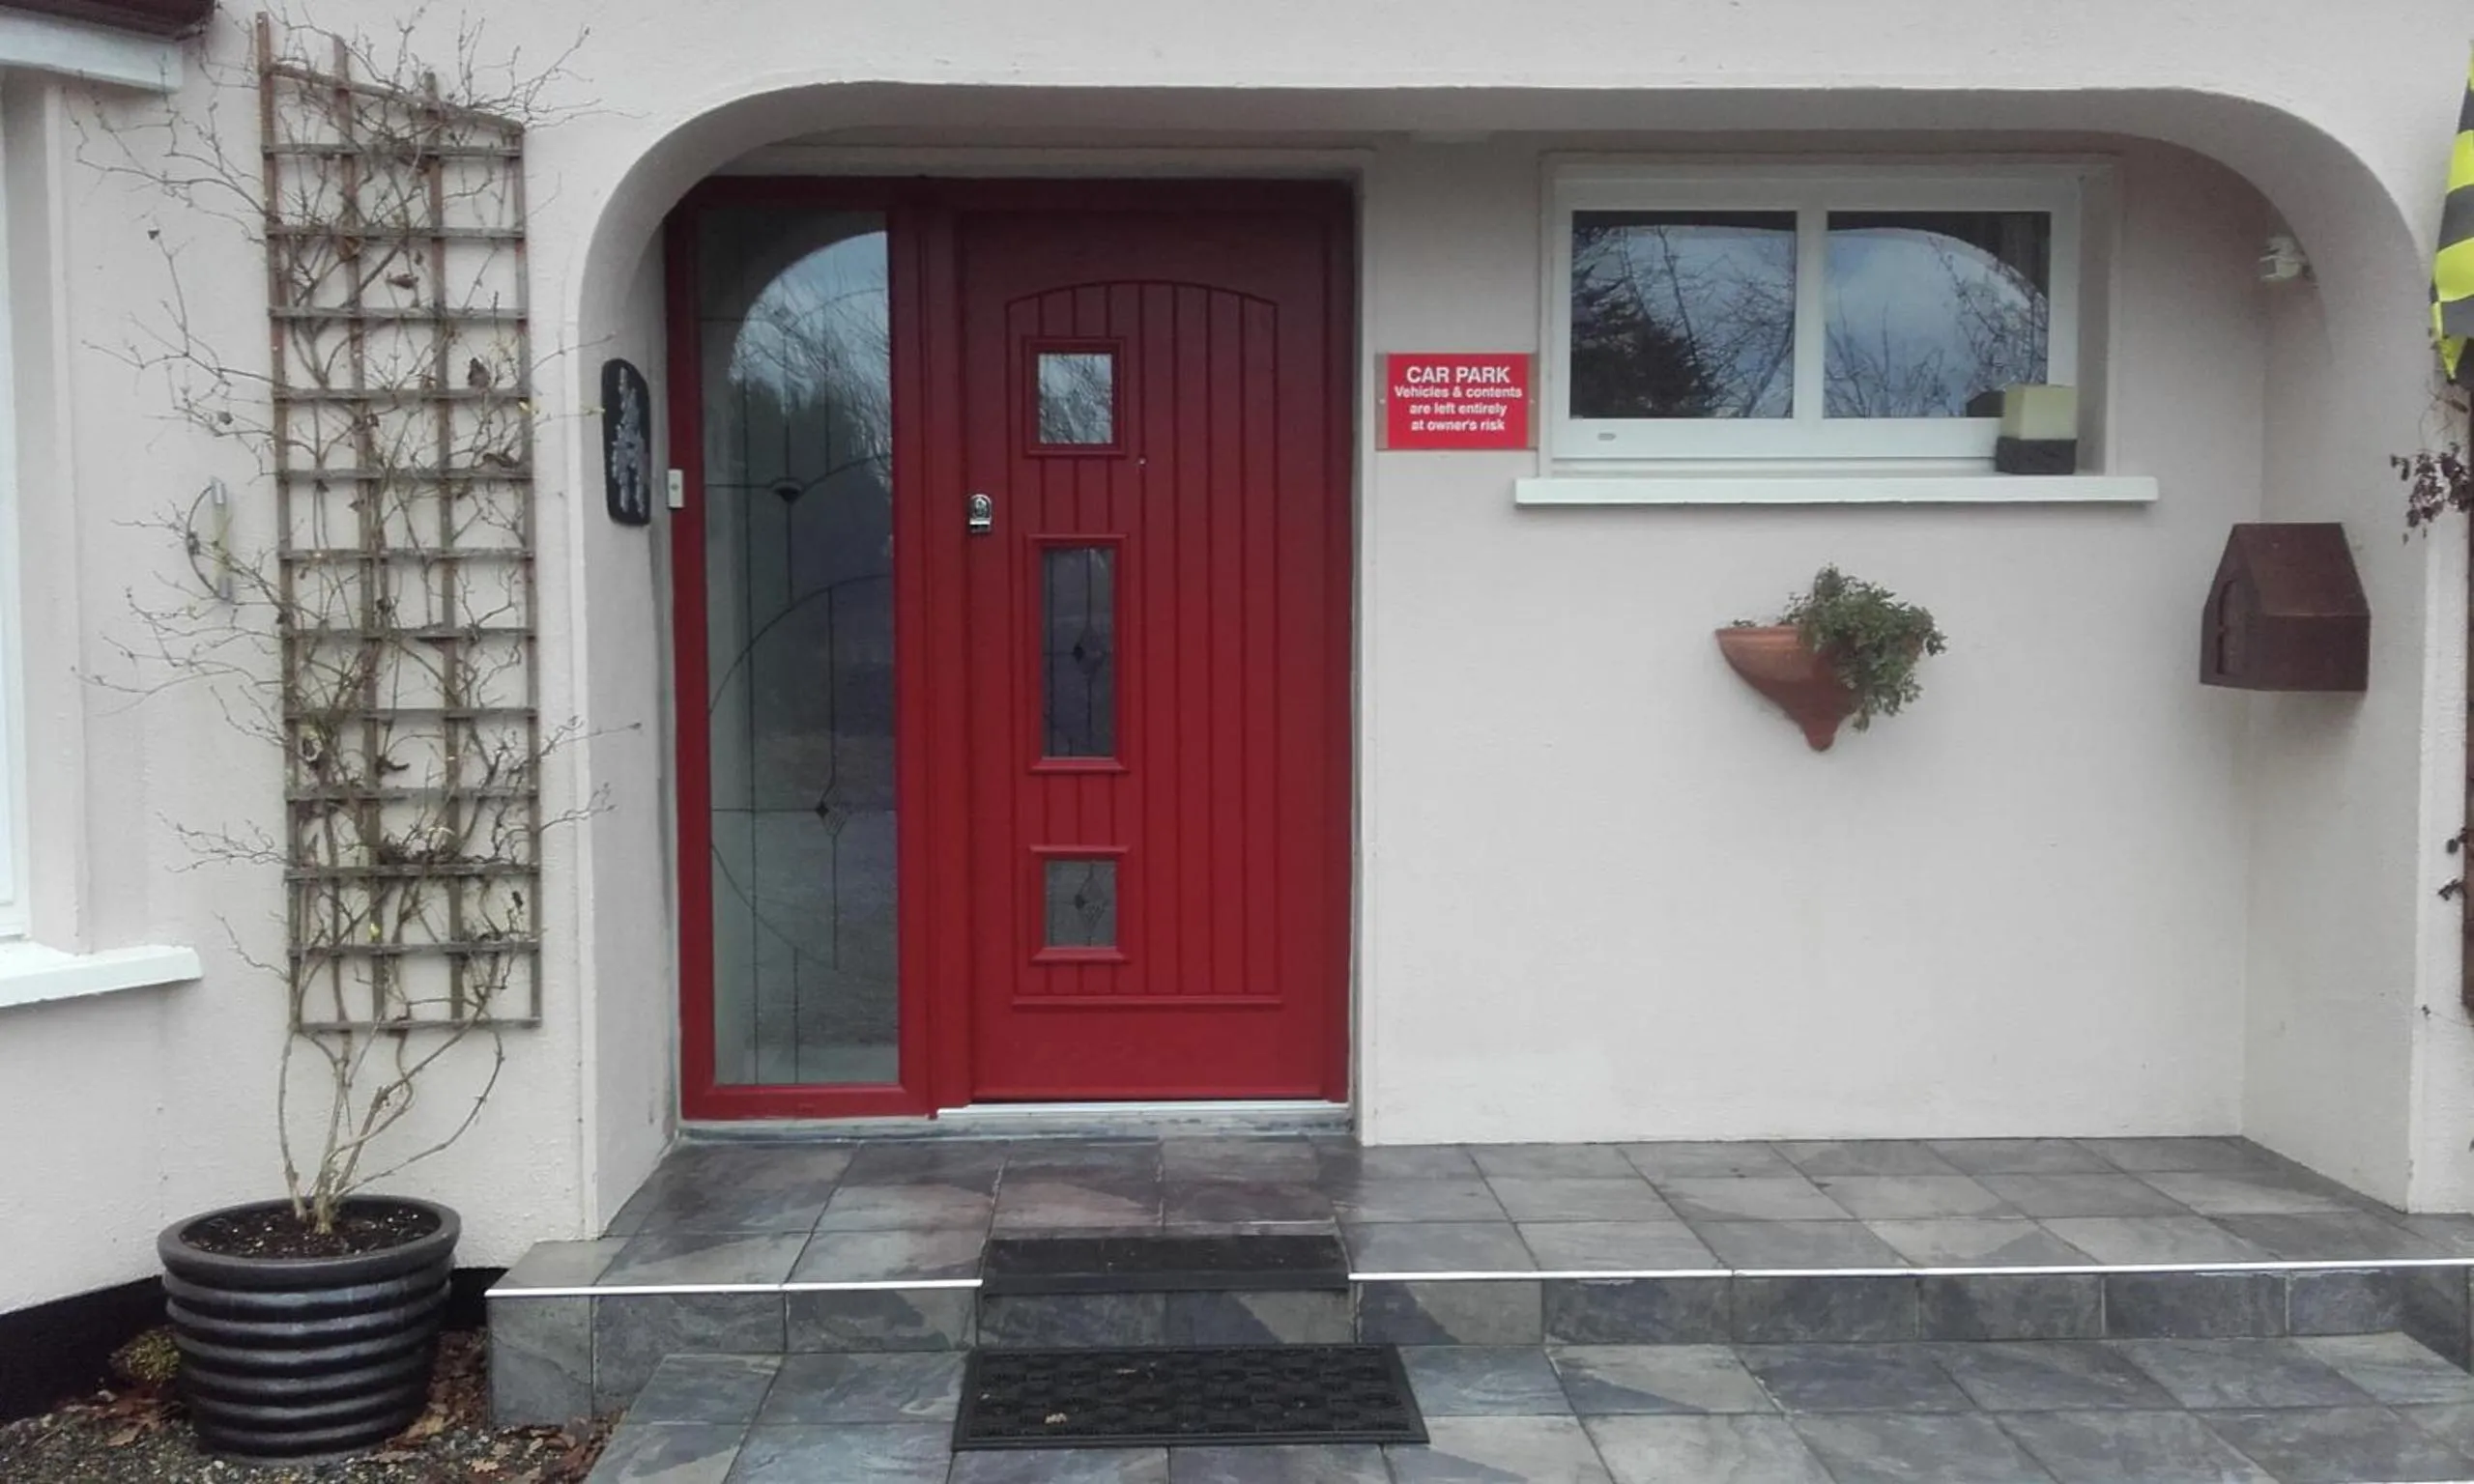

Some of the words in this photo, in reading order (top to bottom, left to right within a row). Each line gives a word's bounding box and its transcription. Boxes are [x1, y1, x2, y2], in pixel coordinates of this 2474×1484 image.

[1406, 366, 1450, 384] CAR
[1455, 366, 1510, 384] PARK
[1394, 385, 1450, 398] Vehicles
[1452, 386, 1462, 398] &
[1465, 386, 1523, 398] contents
[1409, 405, 1431, 414] are
[1433, 402, 1455, 414] left
[1457, 402, 1508, 417] entirely
[1411, 421, 1424, 431] at
[1426, 420, 1478, 431] owner's
[1480, 419, 1505, 431] risk
